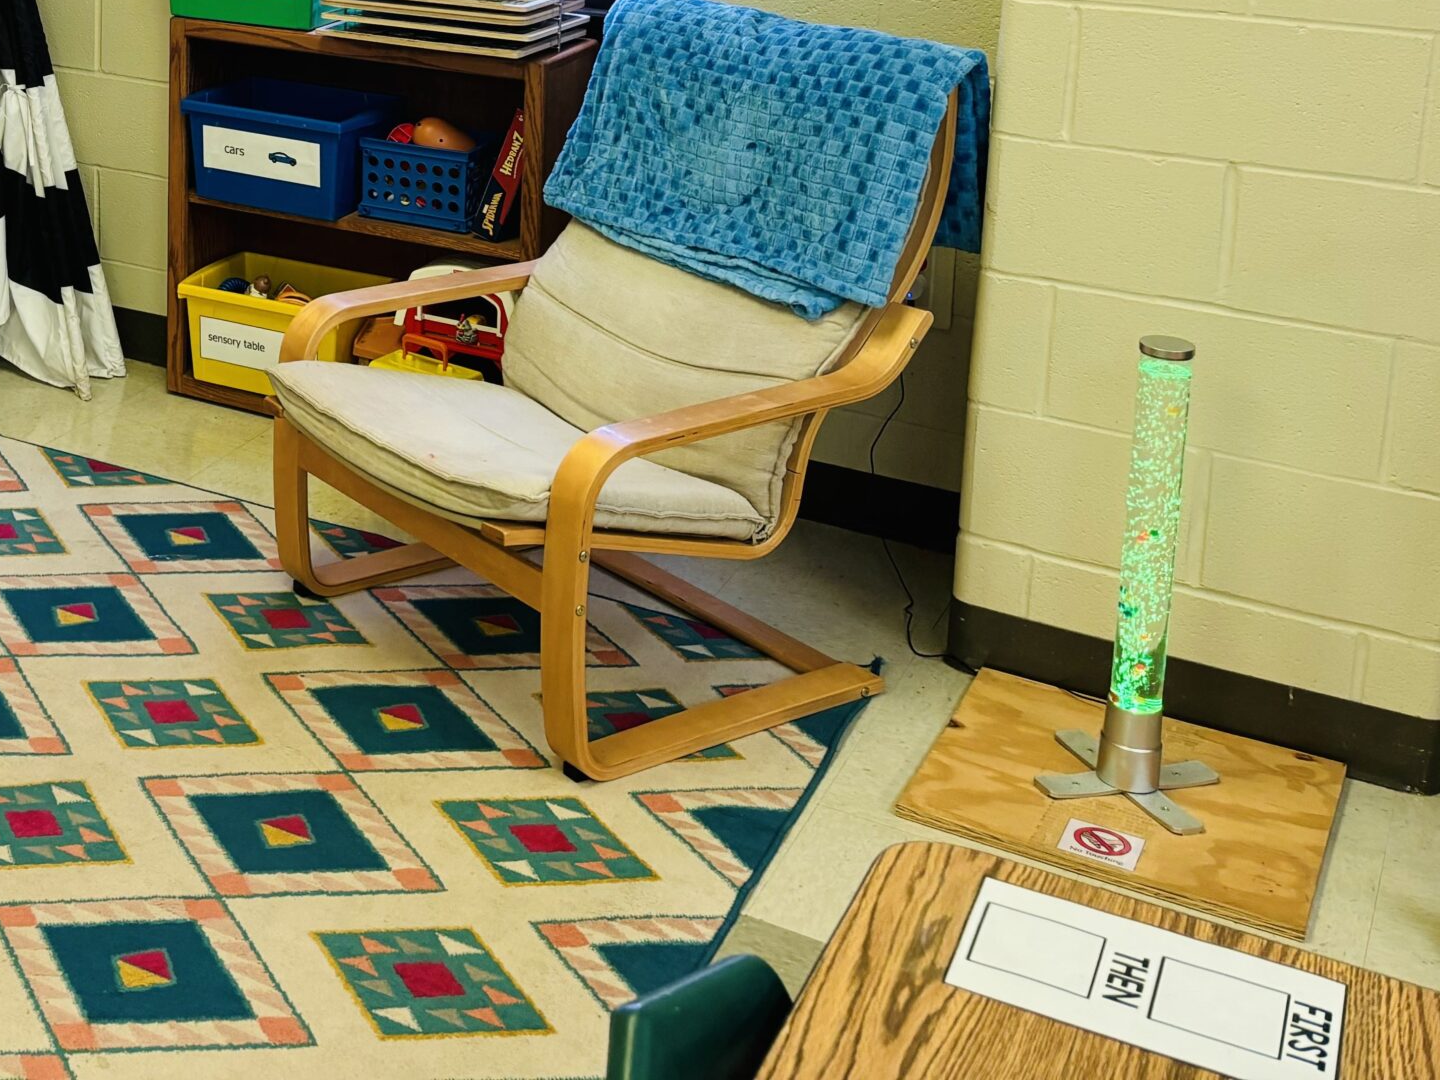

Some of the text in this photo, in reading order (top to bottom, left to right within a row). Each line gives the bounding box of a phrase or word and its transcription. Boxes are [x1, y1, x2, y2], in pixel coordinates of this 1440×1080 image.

[224, 144, 245, 158] cars
[208, 332, 265, 352] sensory table
[1101, 951, 1150, 1009] THEN
[1286, 1000, 1333, 1072] FIRST
